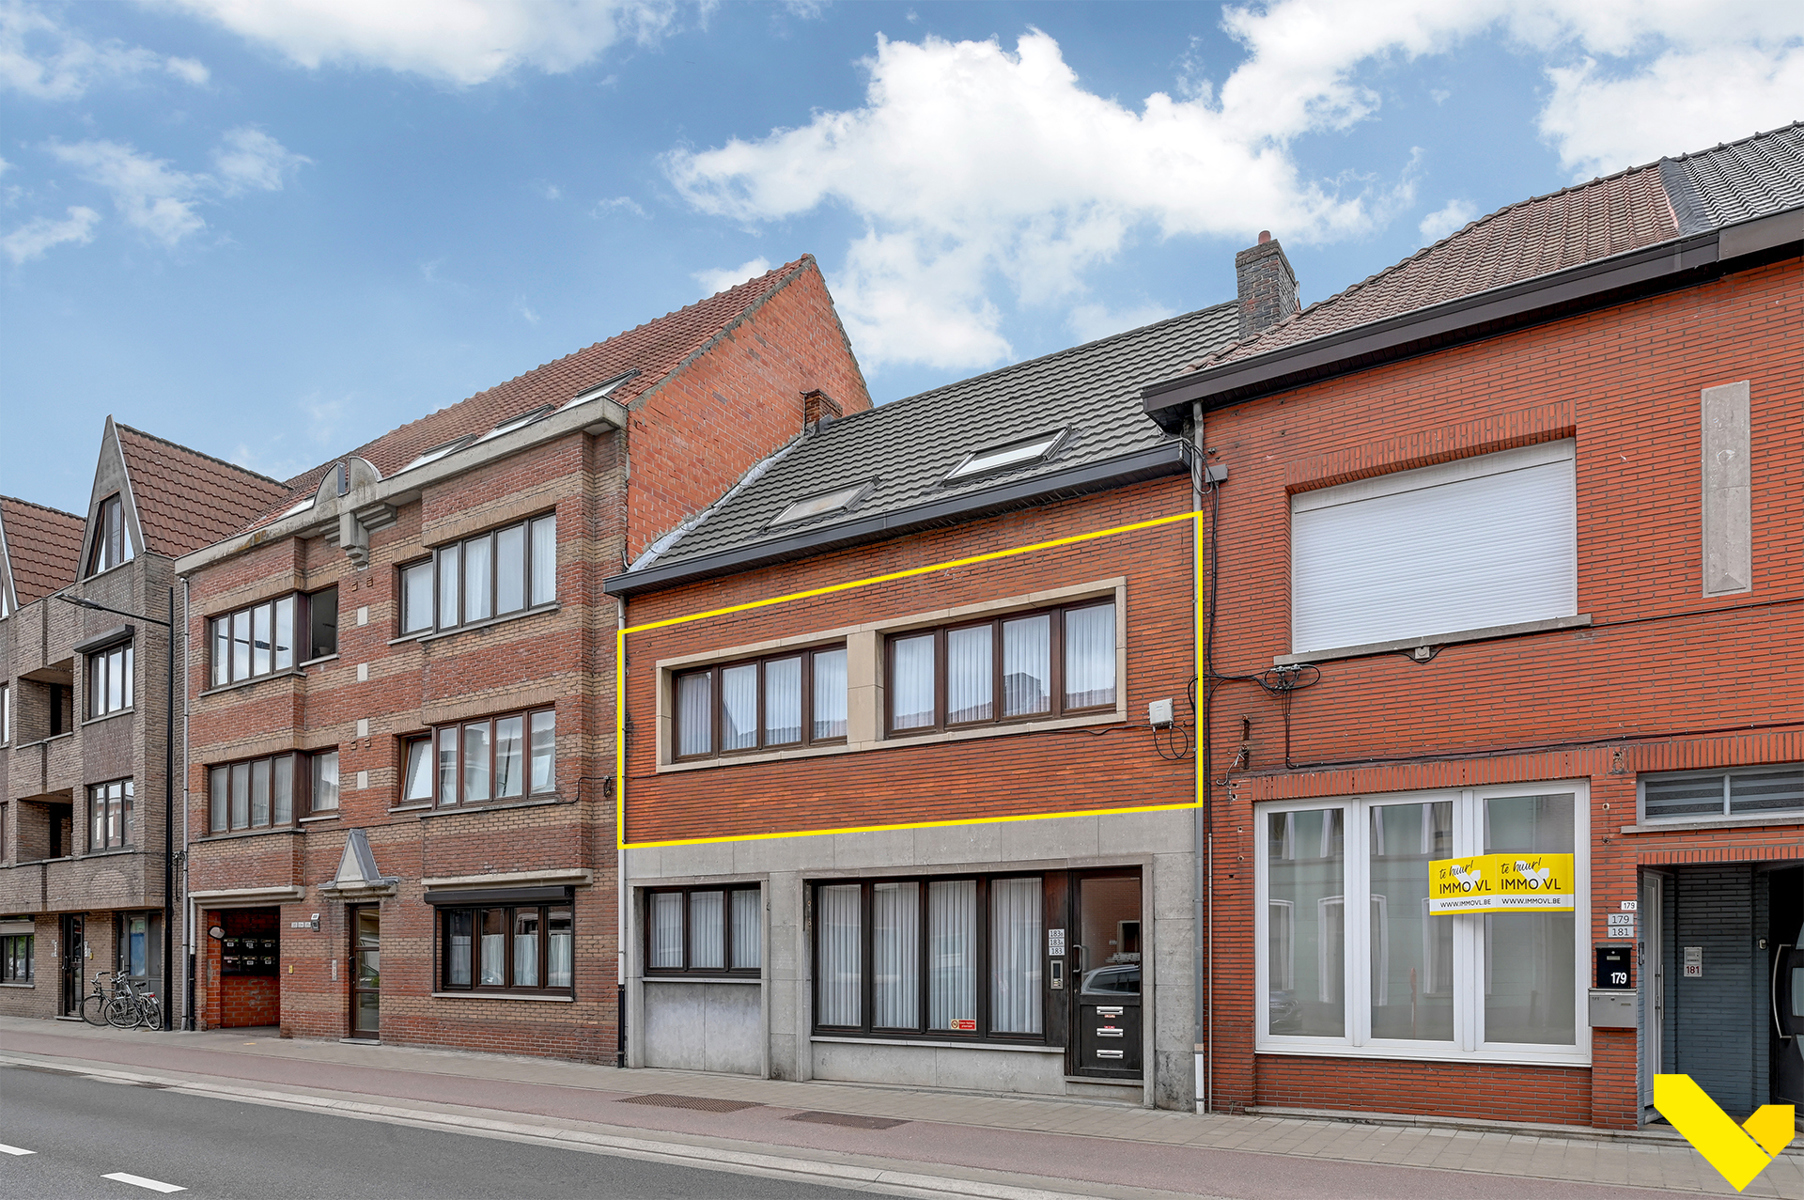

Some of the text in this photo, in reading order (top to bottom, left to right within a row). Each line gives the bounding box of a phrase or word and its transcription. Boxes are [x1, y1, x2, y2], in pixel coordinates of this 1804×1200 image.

[1439, 880, 1492, 894] IMMO VL
[1501, 878, 1562, 890] IMMO VL
[1440, 898, 1492, 908] WWW.IMMOVL.BE
[1501, 897, 1561, 905] WWW.IMMOVL.BE
[1612, 915, 1630, 924] 179
[1612, 928, 1629, 936] 181
[1686, 965, 1700, 974] 181
[1610, 972, 1628, 984] 179
